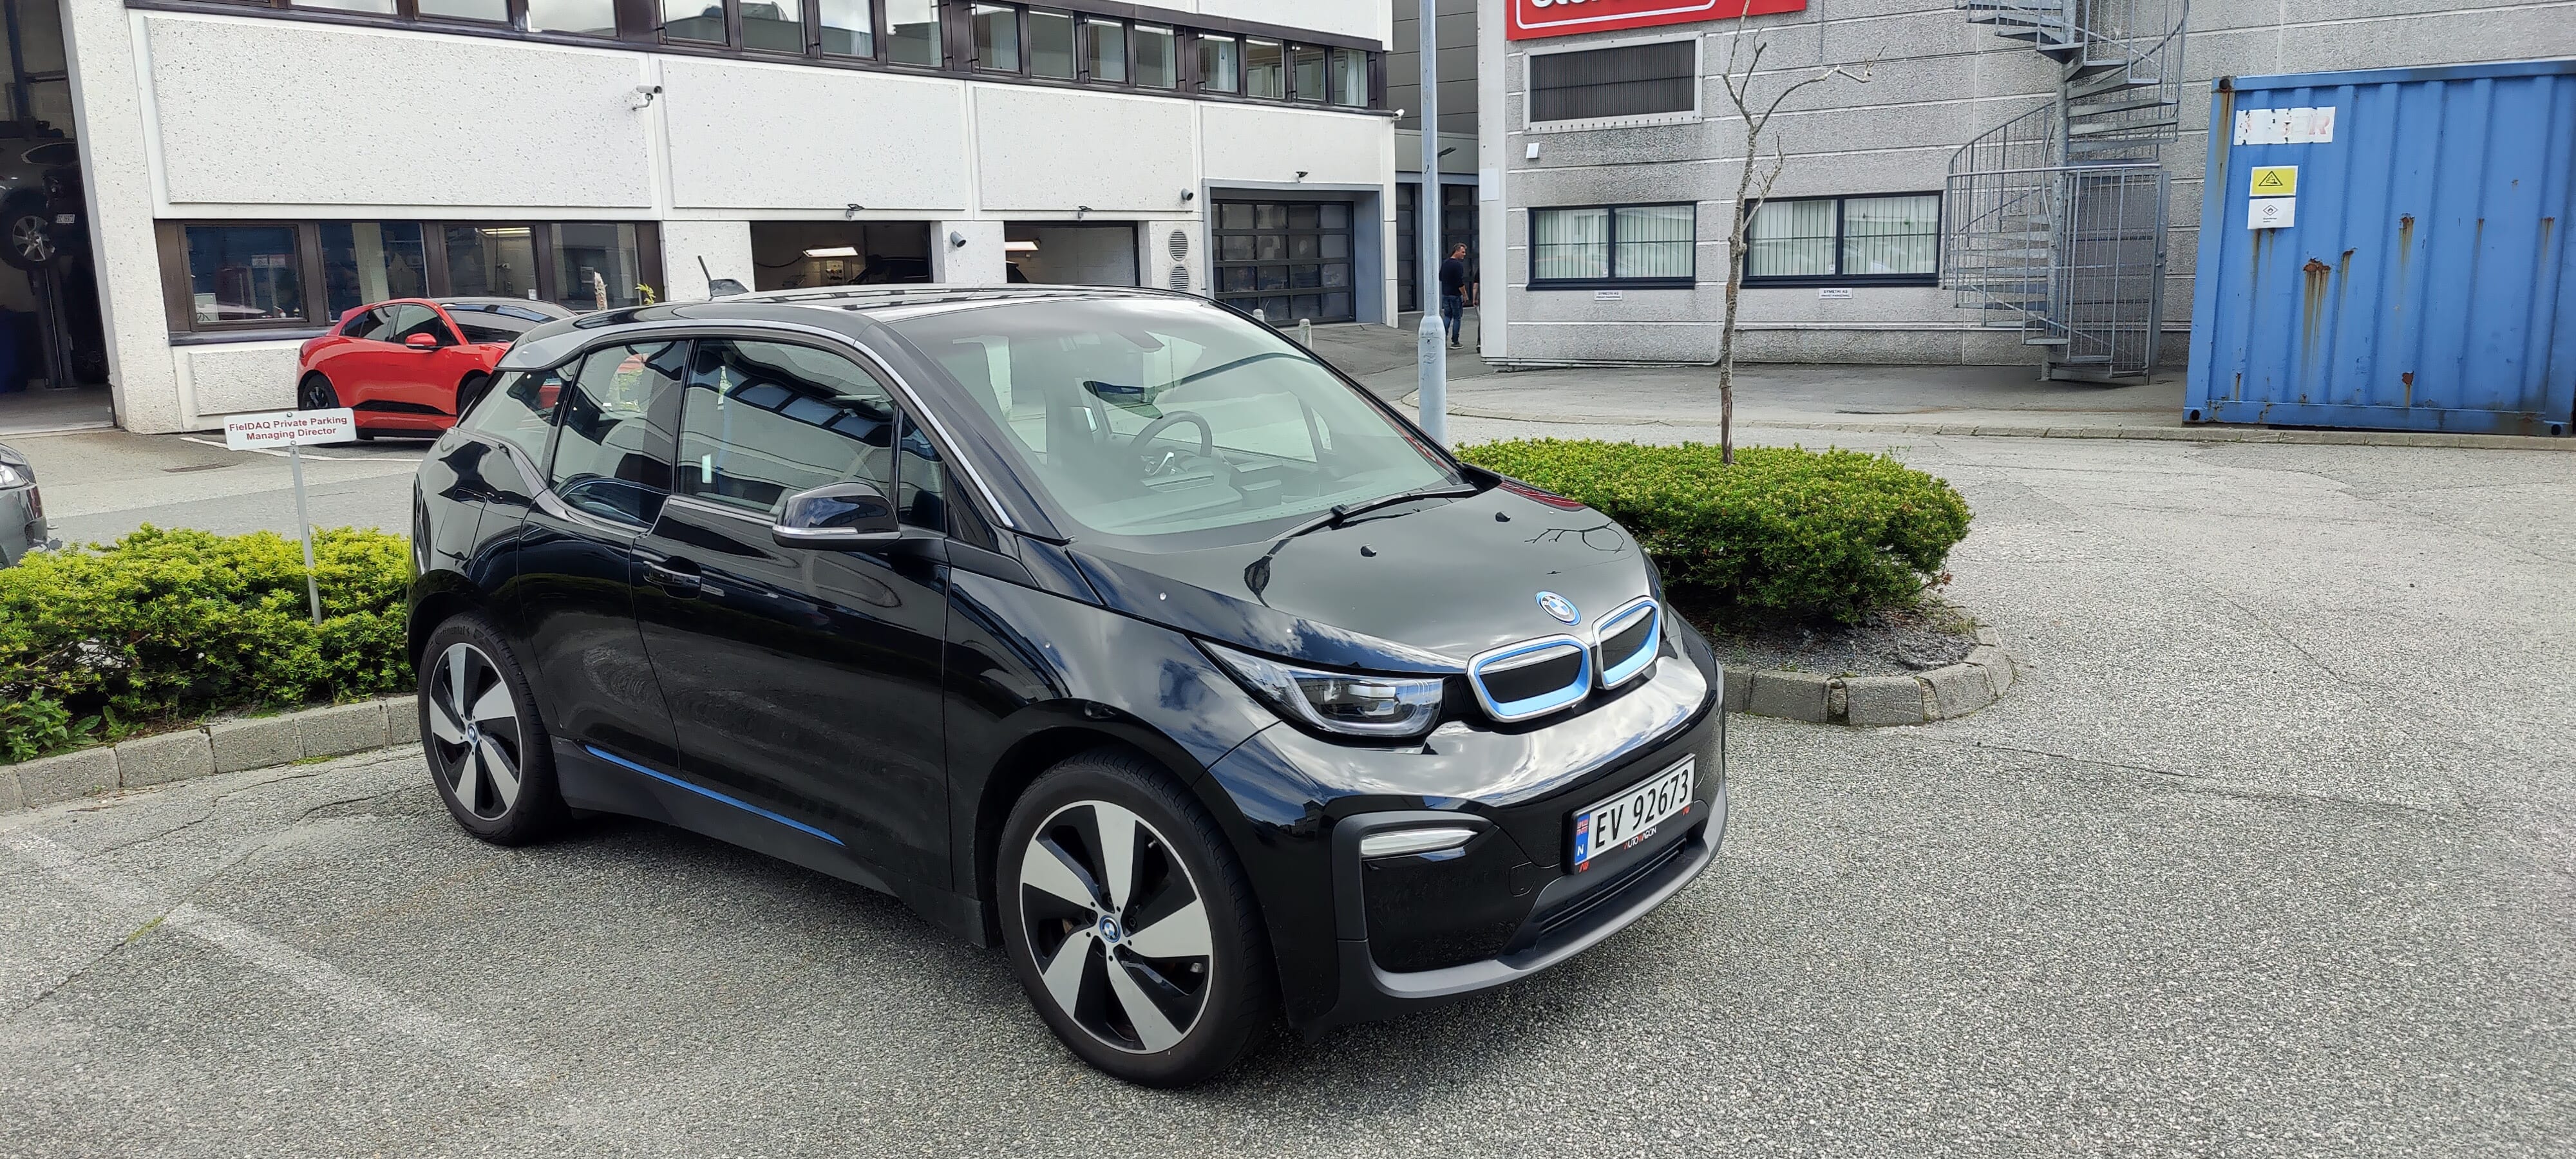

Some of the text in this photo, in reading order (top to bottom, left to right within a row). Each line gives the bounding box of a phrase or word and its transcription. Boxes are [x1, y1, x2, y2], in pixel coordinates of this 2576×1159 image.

[229, 416, 348, 432] FielDAQ Private Parking
[246, 427, 337, 440] Managing Director
[1595, 769, 1689, 849] EV 92673
[1577, 844, 1585, 856] N
